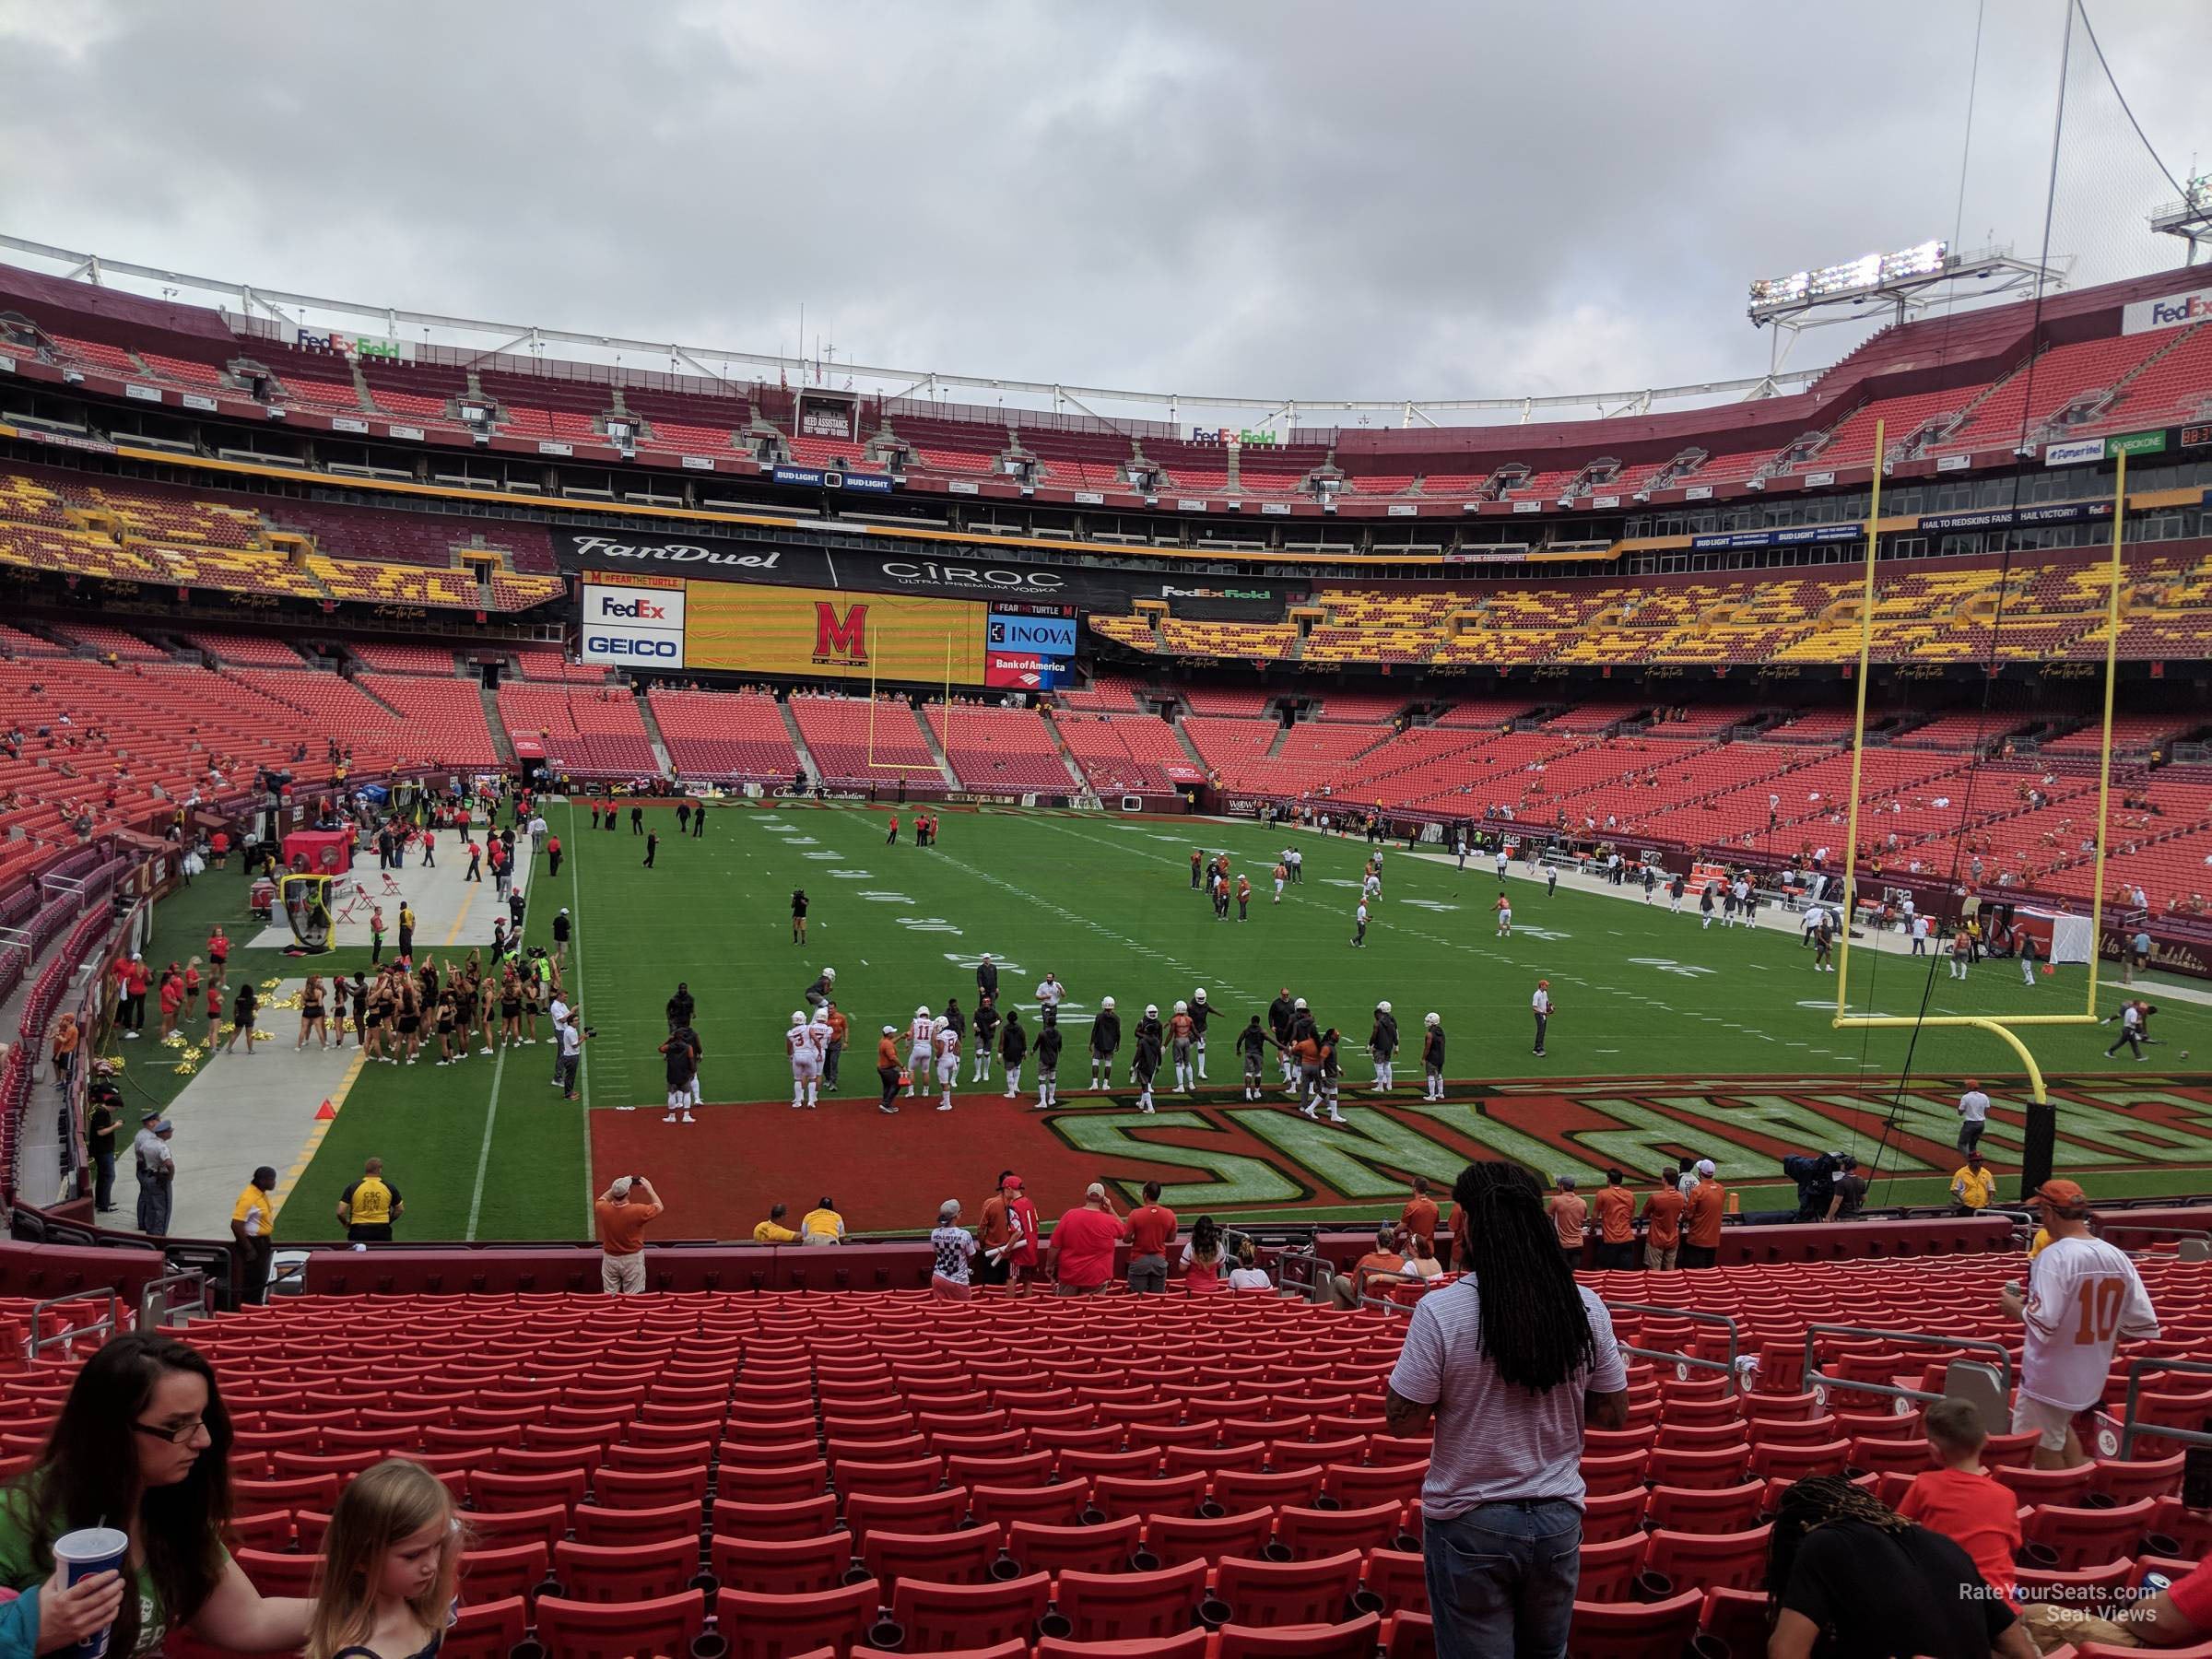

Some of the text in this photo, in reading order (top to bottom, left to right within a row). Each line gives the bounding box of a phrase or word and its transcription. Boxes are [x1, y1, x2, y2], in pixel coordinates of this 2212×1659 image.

[298, 329, 400, 359] FedExField
[804, 416, 849, 430] NEED ASSISTANCE
[1194, 428, 1277, 444] FedExField
[777, 471, 819, 482] BUD LIGHT
[847, 477, 888, 489] BUD LIGHT
[1923, 508, 2078, 530] HAIL TO REDSKINS FANS HAIL VICTORY!
[1711, 537, 1730, 546] LIGHT
[1794, 531, 1815, 539] LIGHT
[572, 535, 782, 569] FanDuel
[591, 571, 678, 588] M #FEARTHETURTLE
[898, 578, 941, 588] ULTRA
[945, 582, 1008, 591] PREMIUM
[1162, 585, 1272, 599] FedExField
[602, 596, 665, 619] FedEx
[995, 603, 1073, 616] #FEARTHETURTLE M
[813, 601, 869, 659] M
[1011, 626, 1072, 645] INOVA
[588, 636, 677, 657] GEICO
[996, 659, 1065, 672] Bank of America
[917, 1022, 929, 1041] 11
[793, 1033, 805, 1048] 3
[363, 1191, 382, 1199] CSC
[2076, 1277, 2126, 1346] 10
